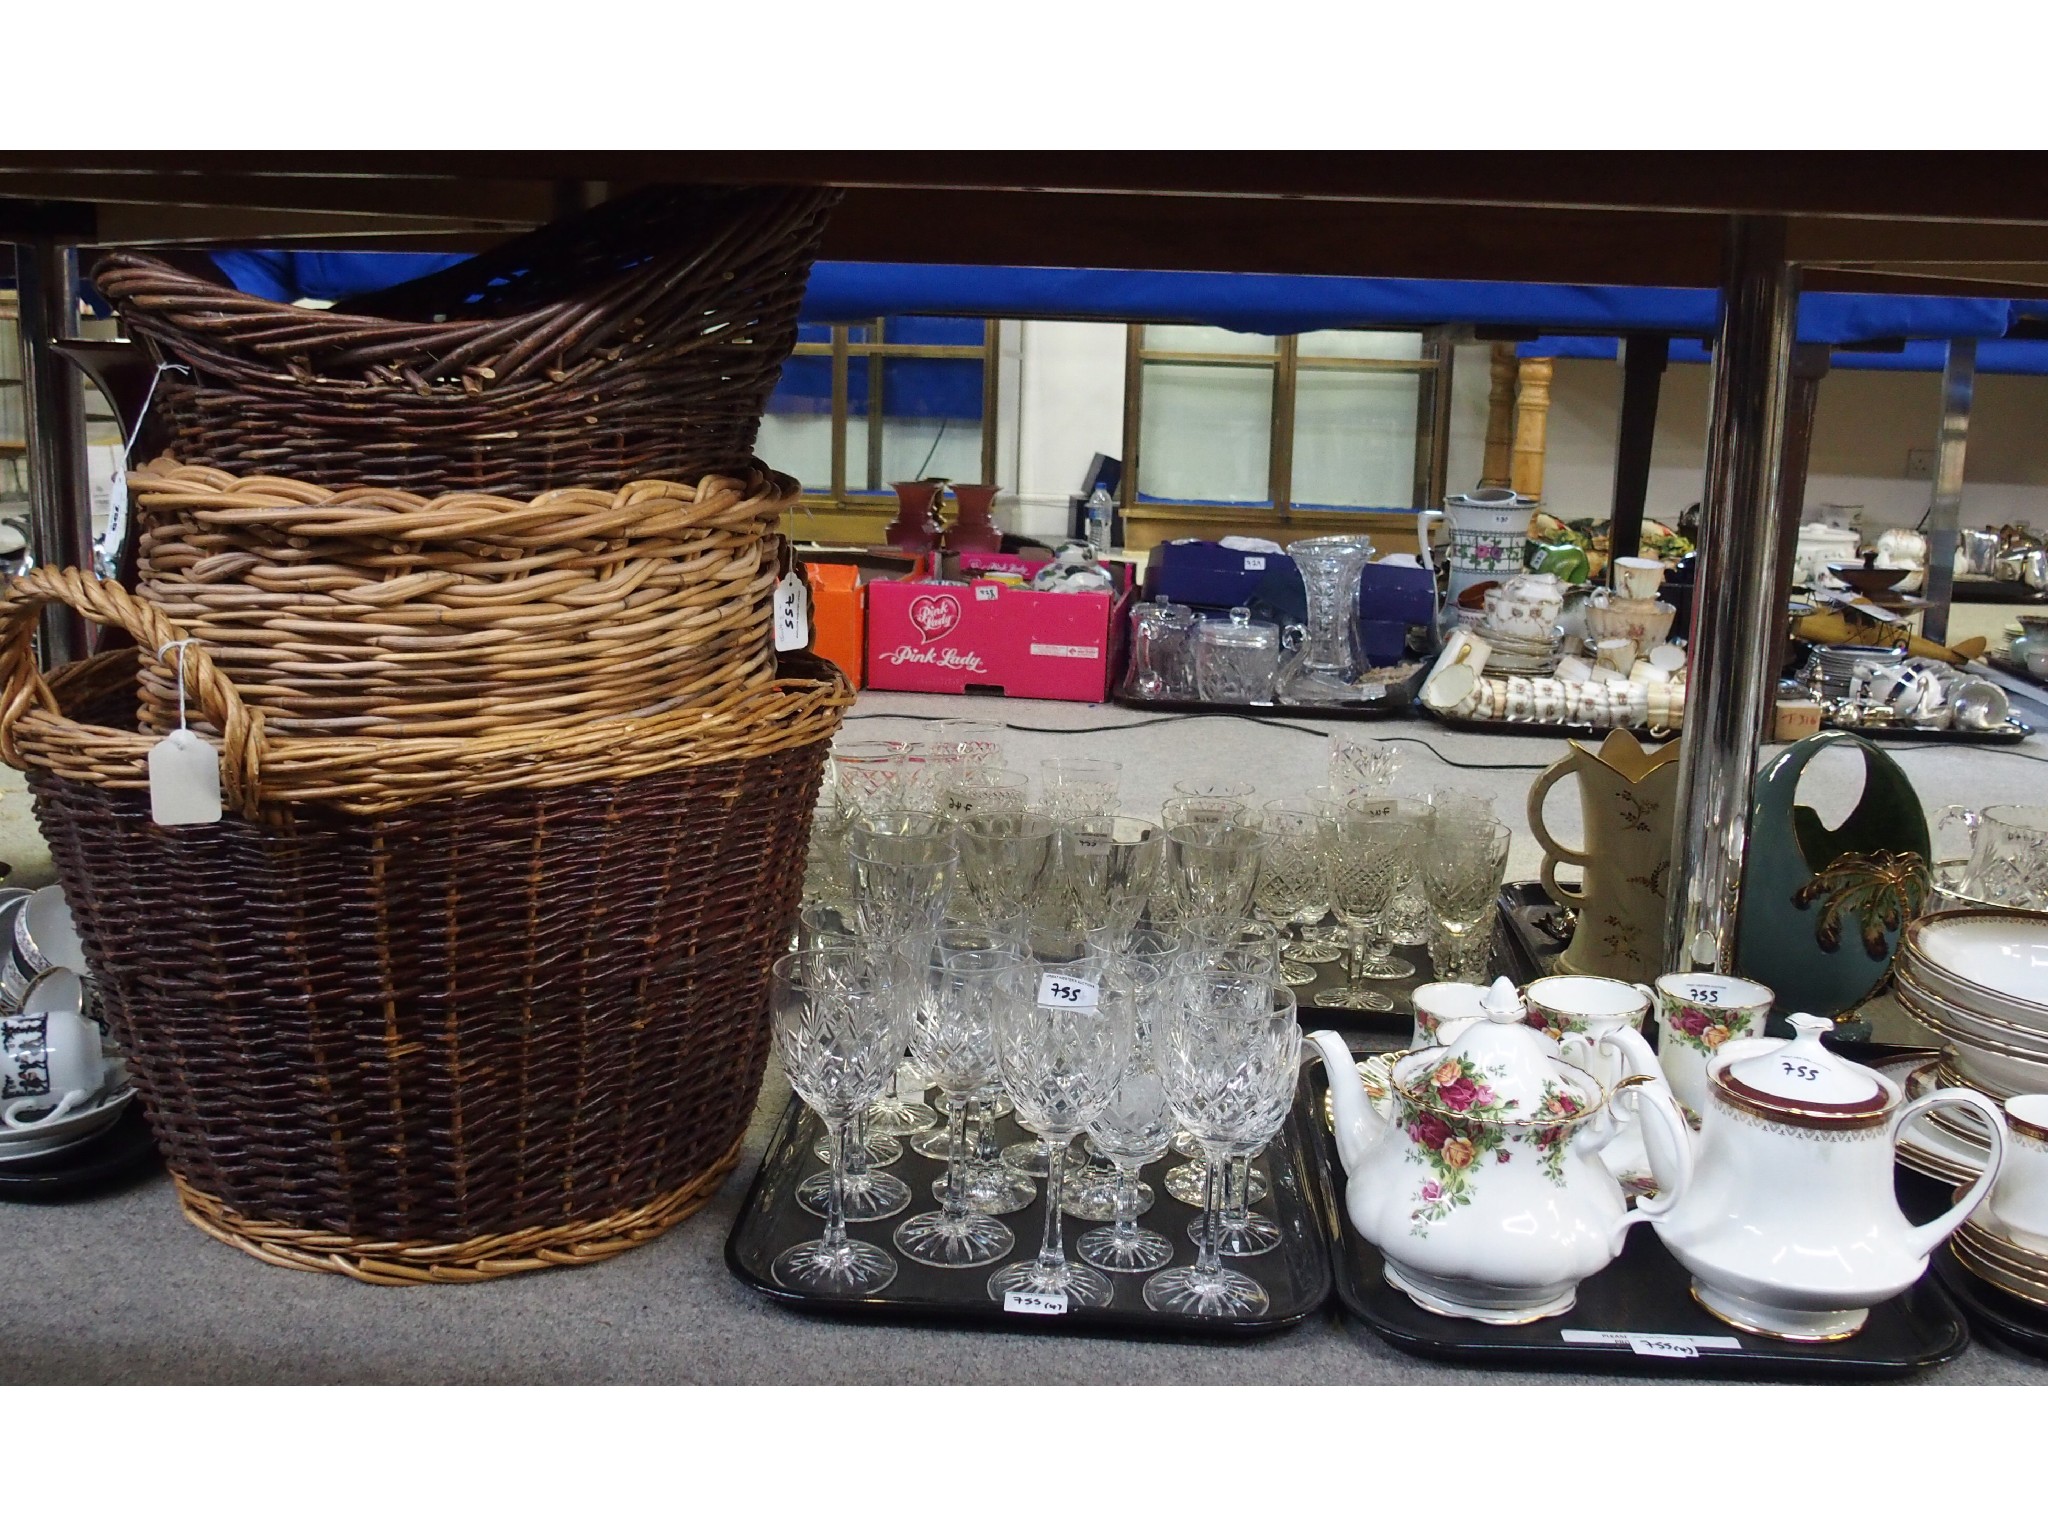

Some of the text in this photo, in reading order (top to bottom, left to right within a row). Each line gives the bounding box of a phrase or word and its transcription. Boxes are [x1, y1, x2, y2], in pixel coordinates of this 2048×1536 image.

[784, 593, 795, 630] 755
[917, 602, 948, 621] Pink
[923, 613, 952, 631] Lady
[879, 646, 987, 674] Pink Lady
[1051, 983, 1081, 1001] 755
[1690, 989, 1718, 1003] 755
[1782, 1062, 1819, 1081] 755
